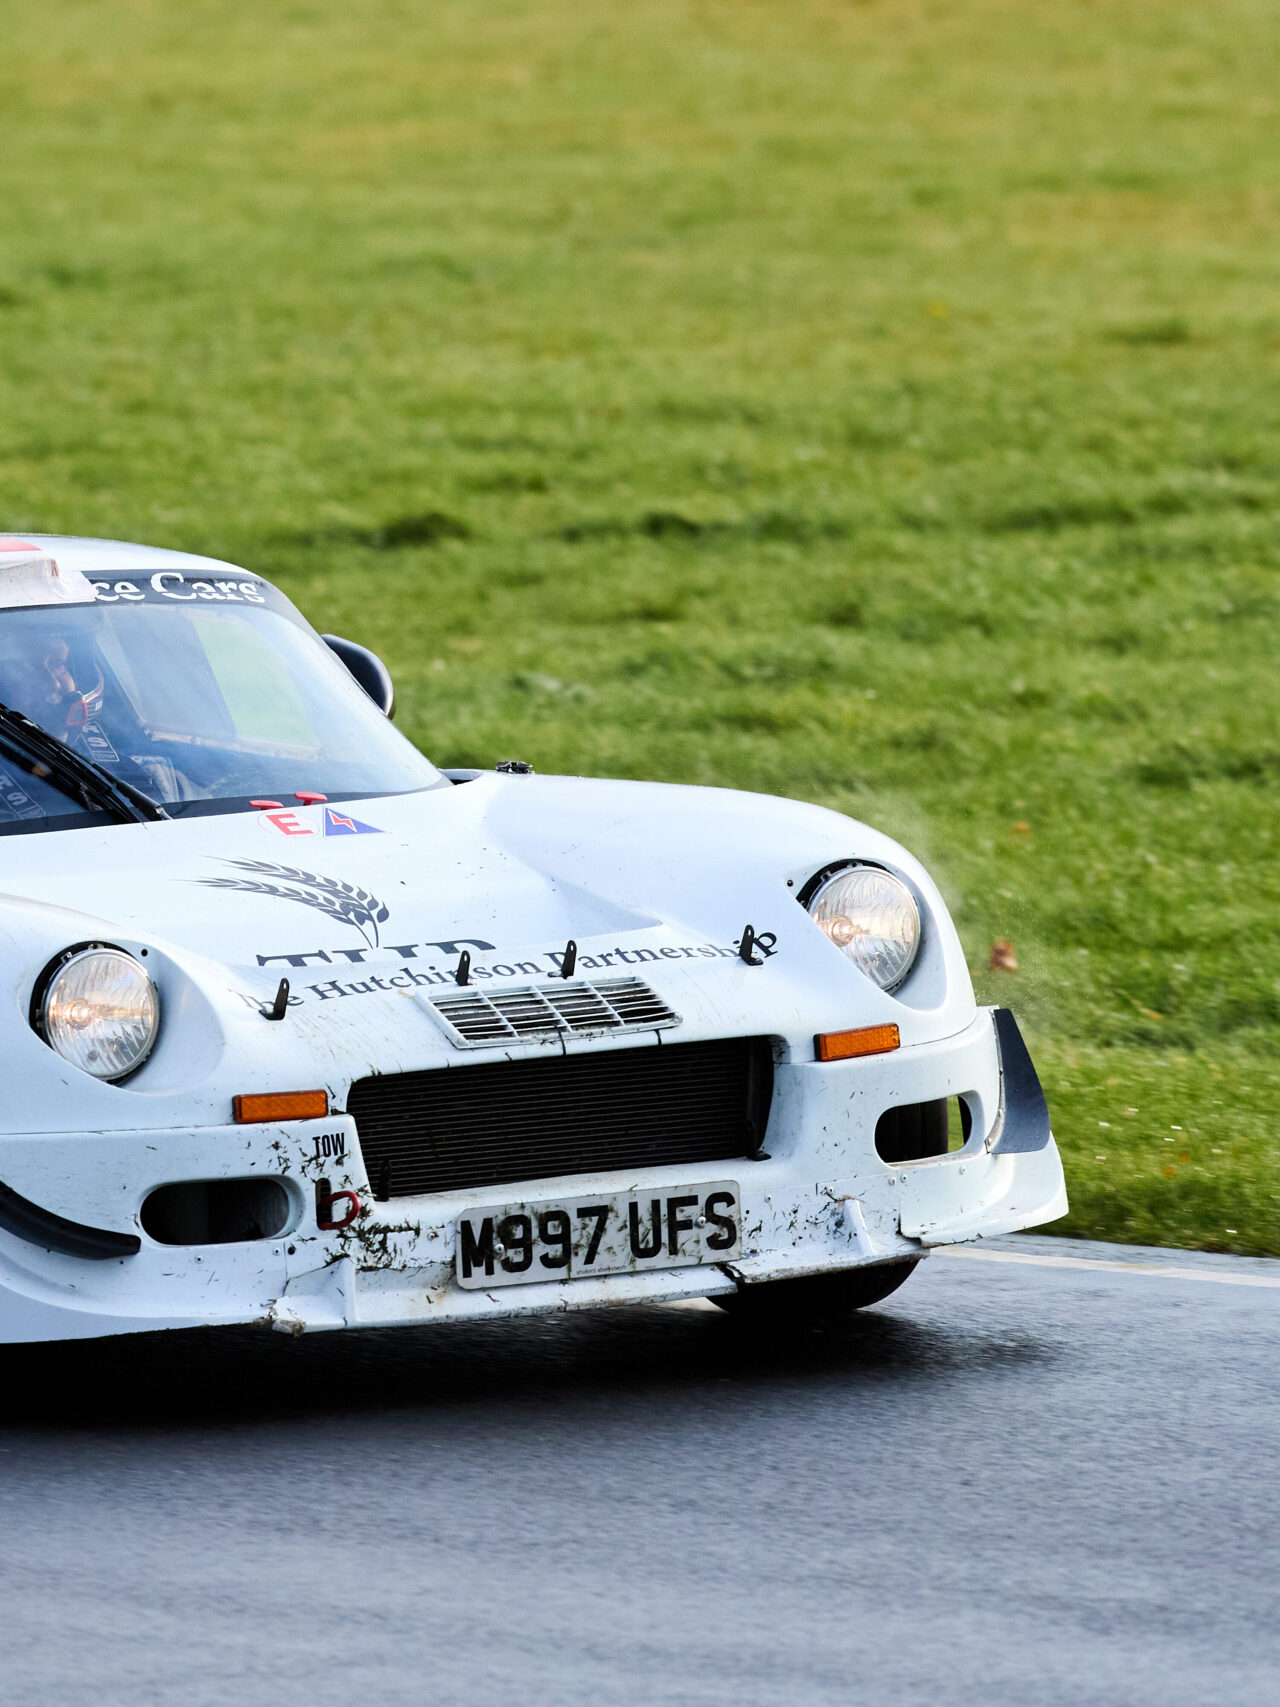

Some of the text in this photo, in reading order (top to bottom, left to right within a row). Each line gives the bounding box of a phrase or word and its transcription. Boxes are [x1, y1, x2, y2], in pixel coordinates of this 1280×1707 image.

[150, 572, 266, 604] Cars
[265, 812, 314, 836] E
[312, 1131, 345, 1158] TOW
[460, 1191, 738, 1279] M997 UFS
